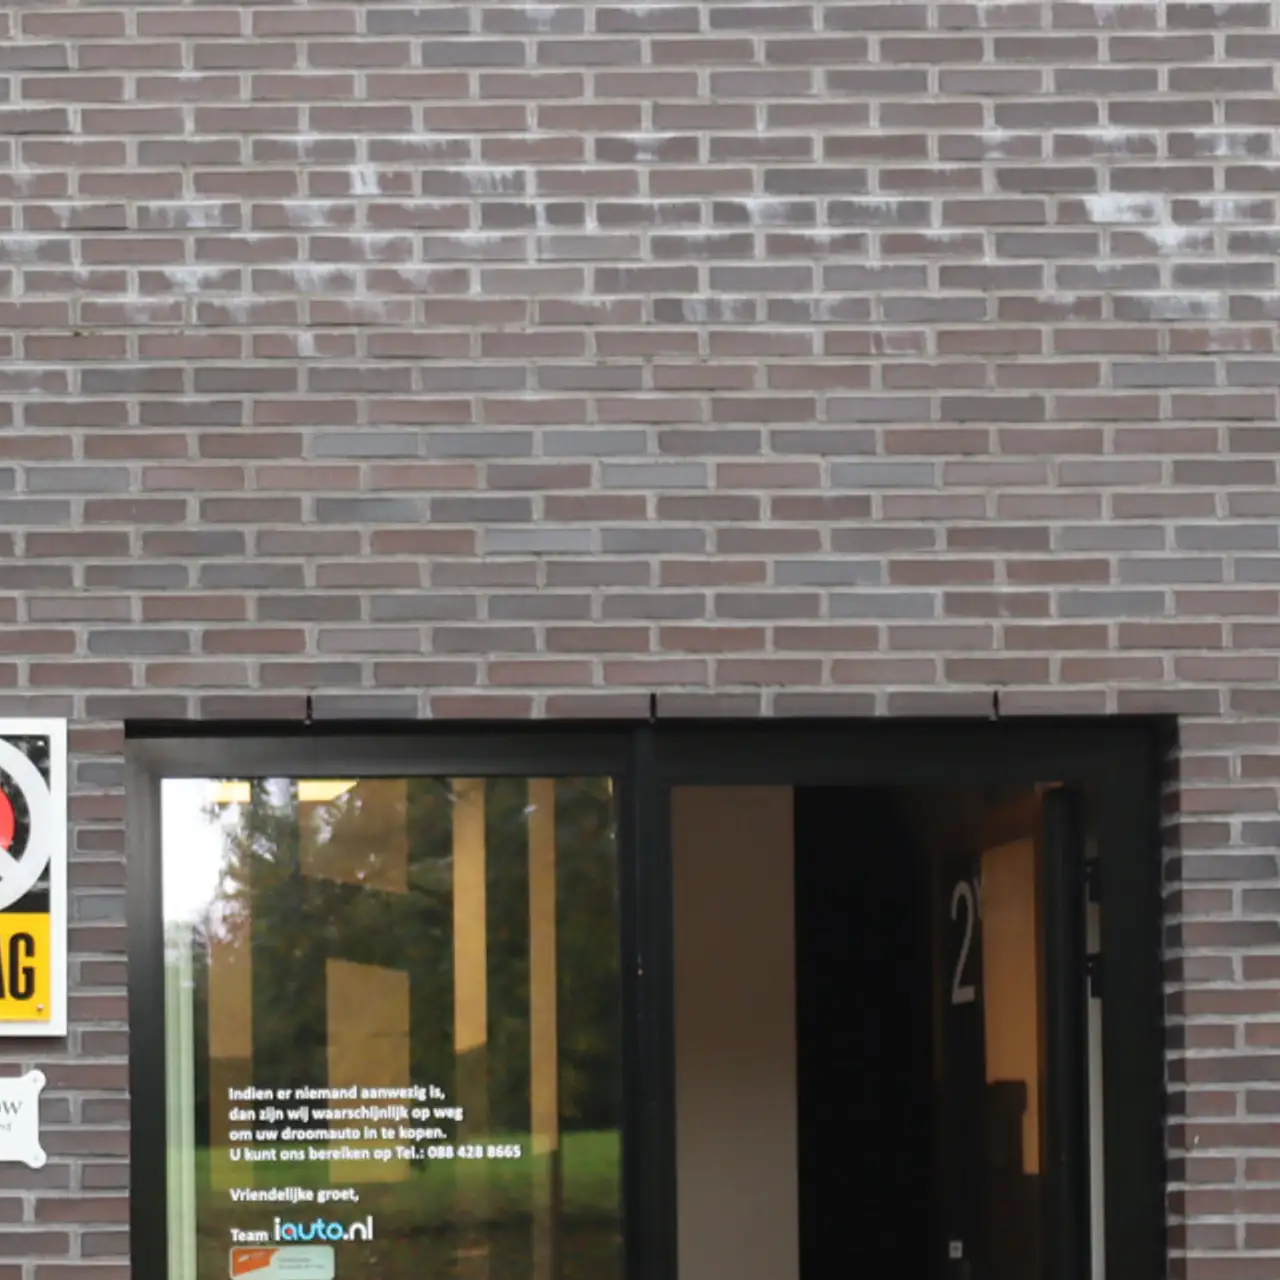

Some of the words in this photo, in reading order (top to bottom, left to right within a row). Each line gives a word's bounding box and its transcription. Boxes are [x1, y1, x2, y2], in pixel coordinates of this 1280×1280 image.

[228, 1087, 274, 1100] Indien
[277, 1088, 293, 1100] er
[295, 1085, 358, 1100] niemand
[361, 1085, 426, 1101] aanwezig
[429, 1084, 445, 1100] is,
[229, 1106, 256, 1121] dan
[259, 1106, 284, 1123] zijn
[286, 1106, 309, 1123] wij
[311, 1105, 408, 1121] waarschijnlijk
[411, 1107, 431, 1121] op
[433, 1107, 463, 1121] weg
[229, 1130, 253, 1141] om
[255, 1130, 279, 1141] uw
[281, 1126, 360, 1141] droomauto
[363, 1126, 377, 1140] in
[381, 1127, 396, 1140] te
[398, 1126, 447, 1142] kopen.
[230, 1148, 241, 1161] U
[243, 1147, 277, 1160] kunt
[280, 1149, 305, 1160] ons
[308, 1146, 370, 1160] bereiken
[373, 1149, 392, 1162] op
[395, 1146, 425, 1160] Tel.:
[427, 1145, 454, 1159] 088
[457, 1145, 484, 1159] 428
[486, 1144, 522, 1159] 8665
[230, 1187, 314, 1203] Vriendelijke
[317, 1188, 359, 1203] groet,
[230, 1228, 269, 1241] Team
[274, 1215, 373, 1241] iauto.nl
